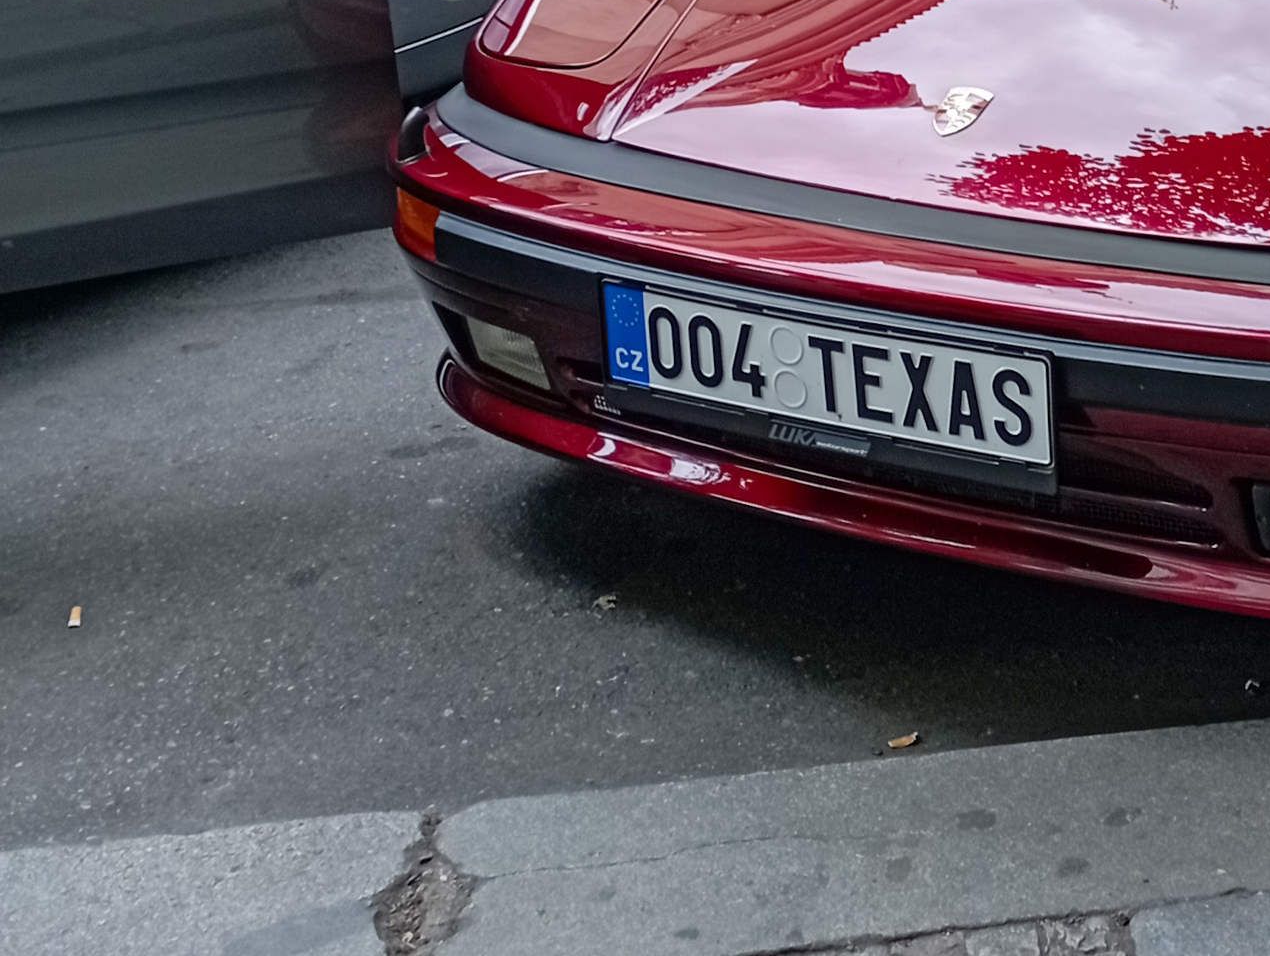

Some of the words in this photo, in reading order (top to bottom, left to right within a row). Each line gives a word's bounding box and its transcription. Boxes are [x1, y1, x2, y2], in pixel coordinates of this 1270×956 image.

[614, 347, 644, 373] CZ
[648, 306, 766, 398] 004
[808, 335, 1033, 447] TEXAS
